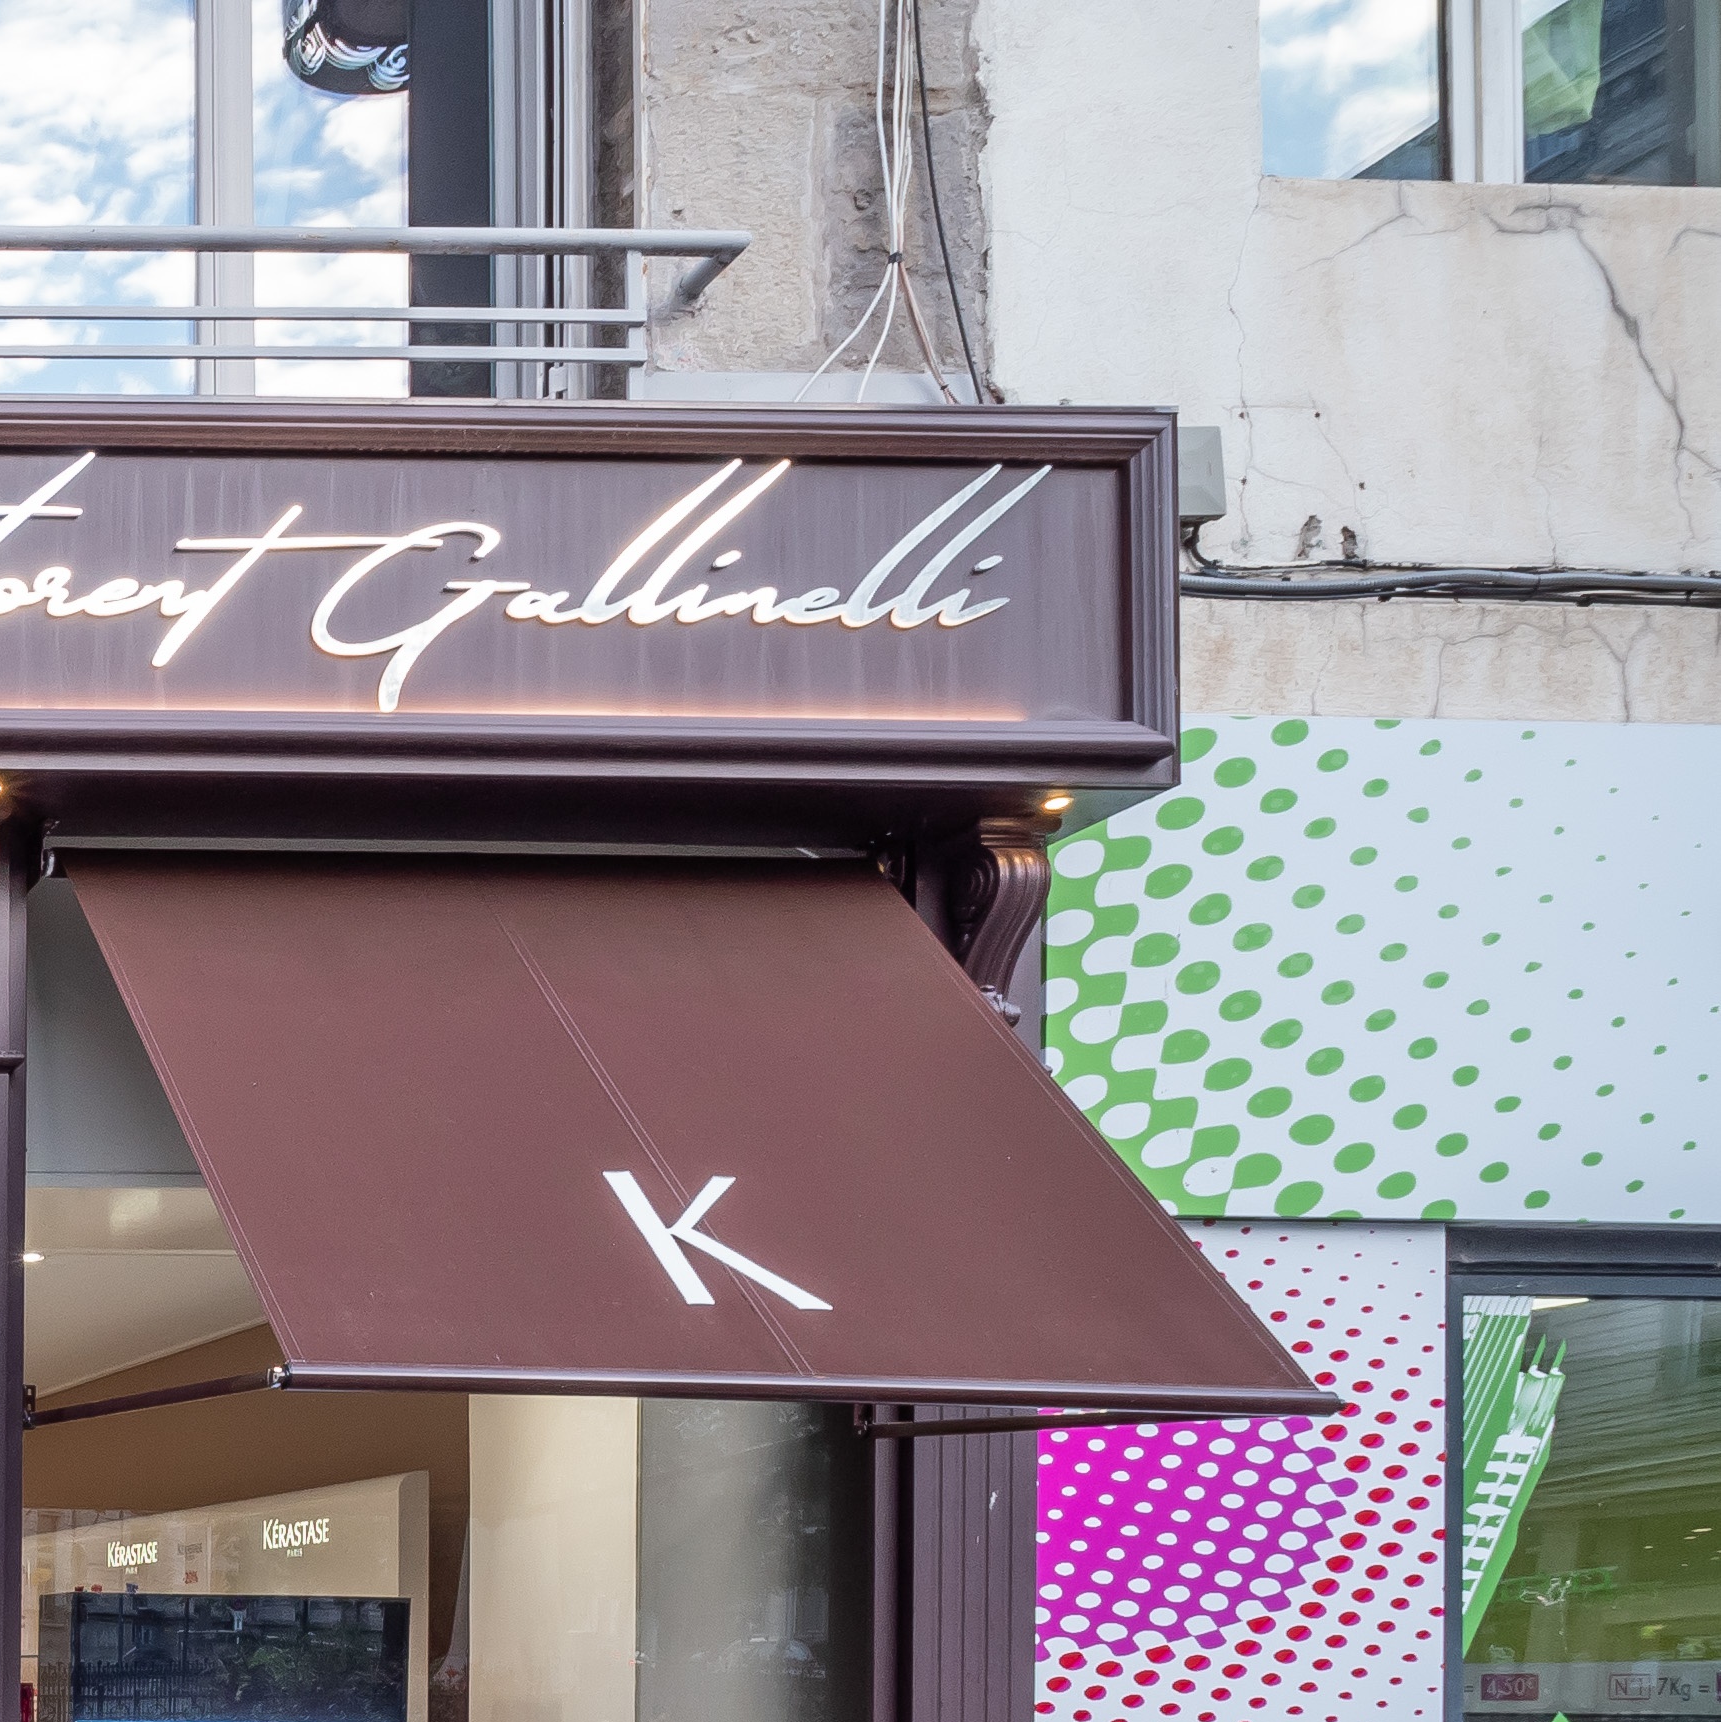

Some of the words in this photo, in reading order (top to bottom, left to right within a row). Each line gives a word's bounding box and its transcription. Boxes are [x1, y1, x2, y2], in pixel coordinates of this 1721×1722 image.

[309, 458, 1053, 714] Gallinelli
[601, 1169, 834, 1312] K
[107, 1540, 158, 1568] KÉRASTASE
[262, 1517, 330, 1550] KÉRASTASE
